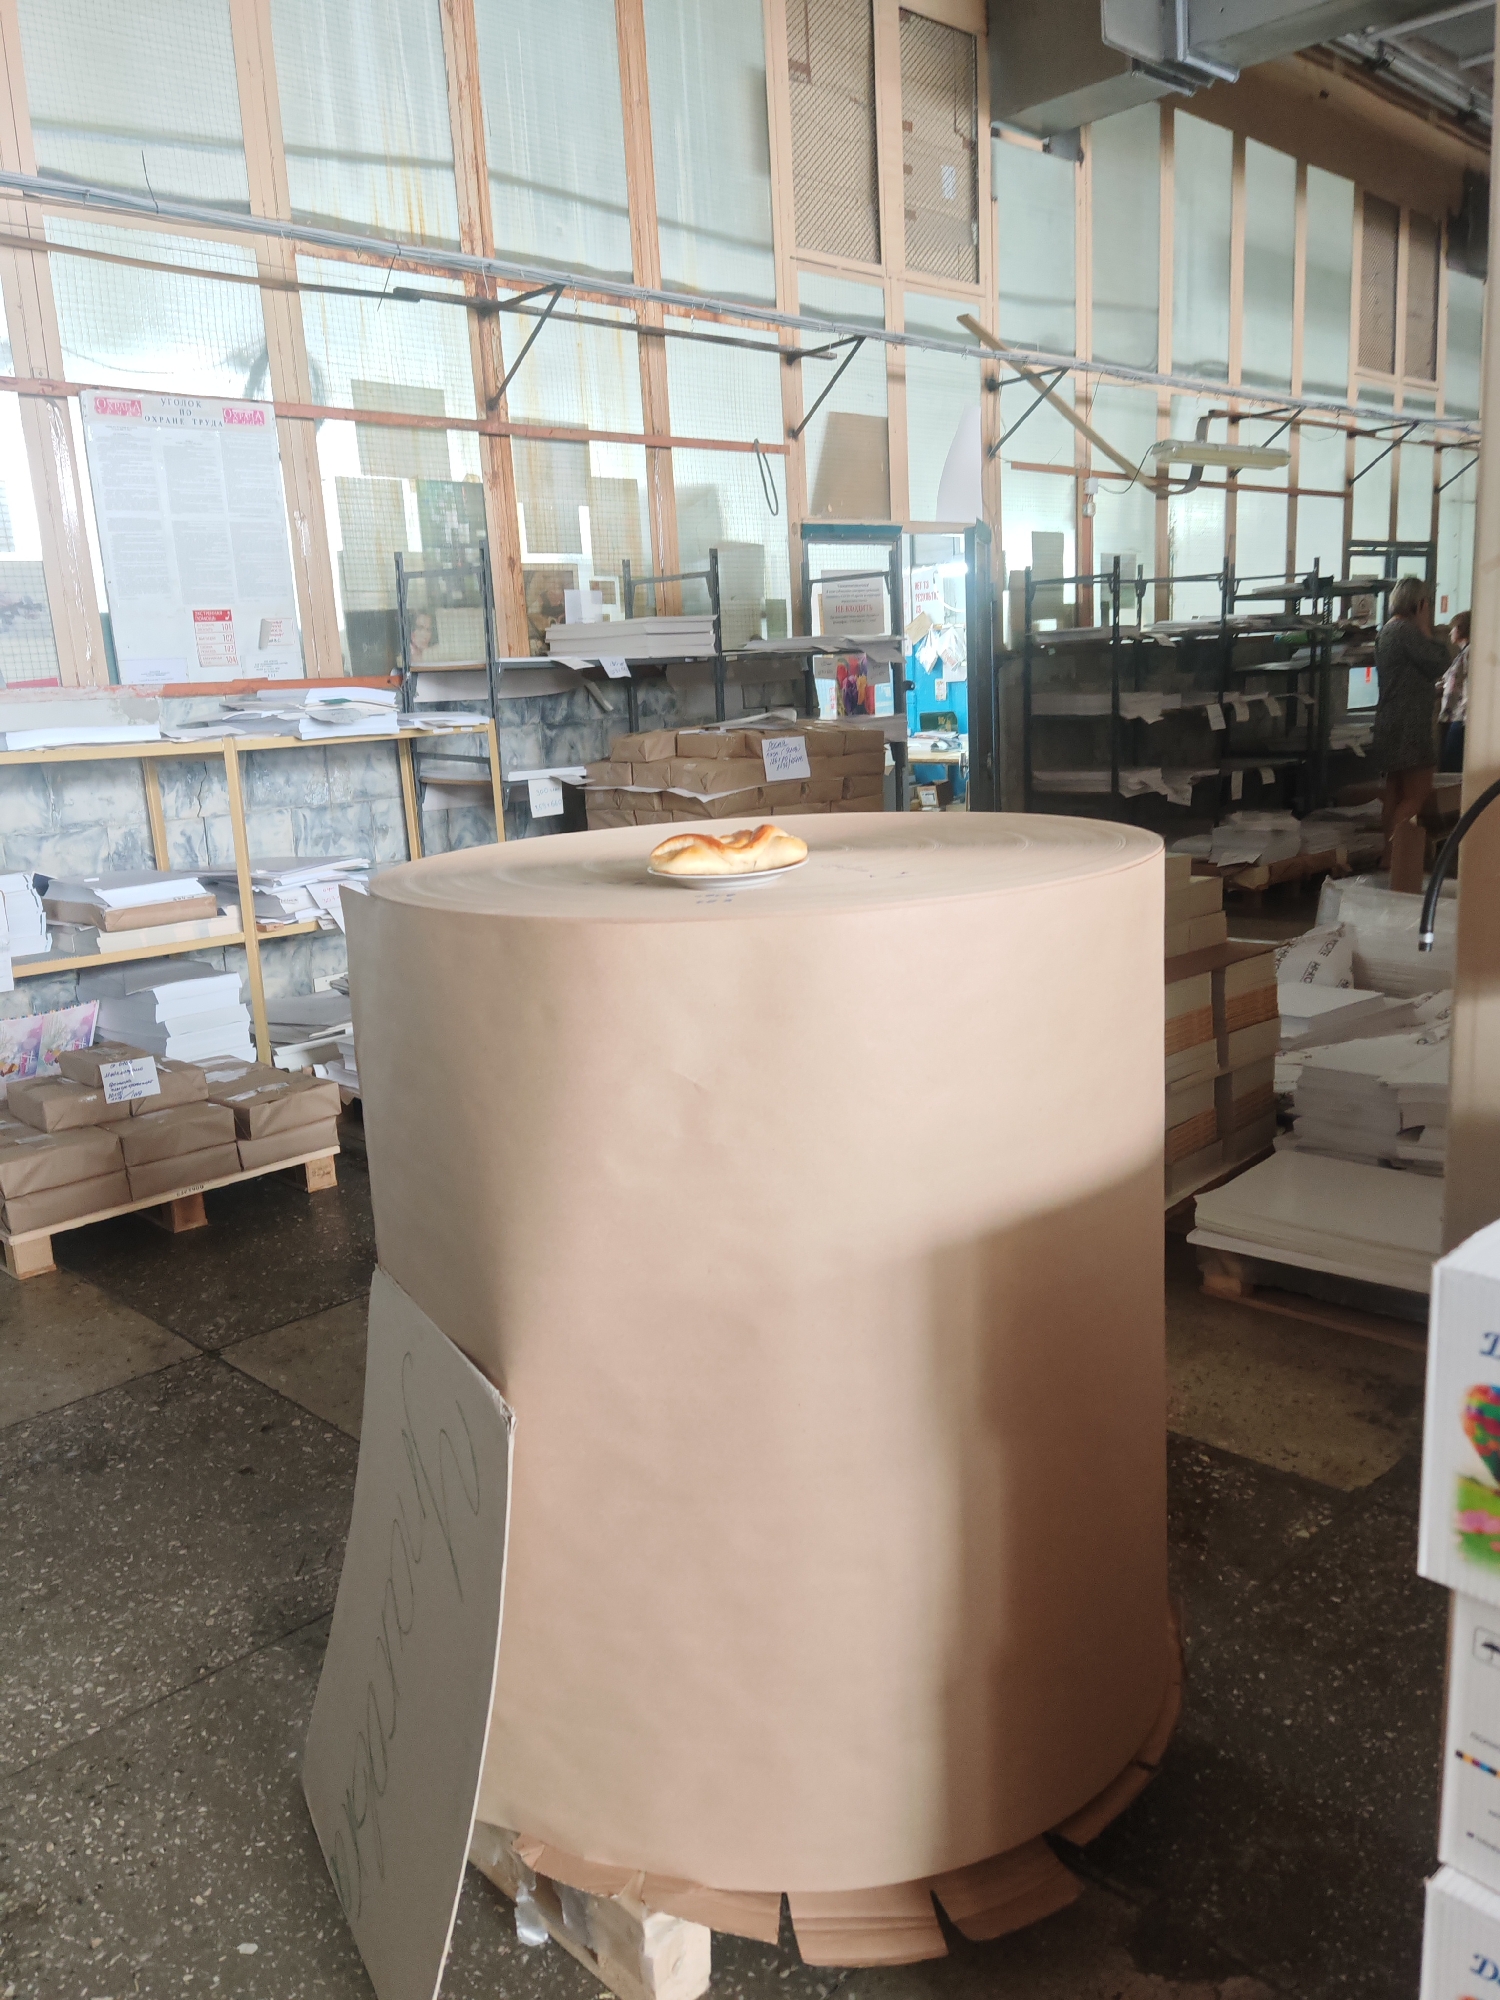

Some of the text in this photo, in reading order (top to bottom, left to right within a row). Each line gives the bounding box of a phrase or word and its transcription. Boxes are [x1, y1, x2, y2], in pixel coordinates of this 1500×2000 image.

[160, 398, 202, 408] УГОЛОК
[144, 415, 223, 428] ОХРАНЕ ТРУДА
[221, 623, 232, 631] 101
[222, 634, 233, 643] 102
[224, 645, 235, 653] 103
[329, 1351, 481, 1922] Упаковка
